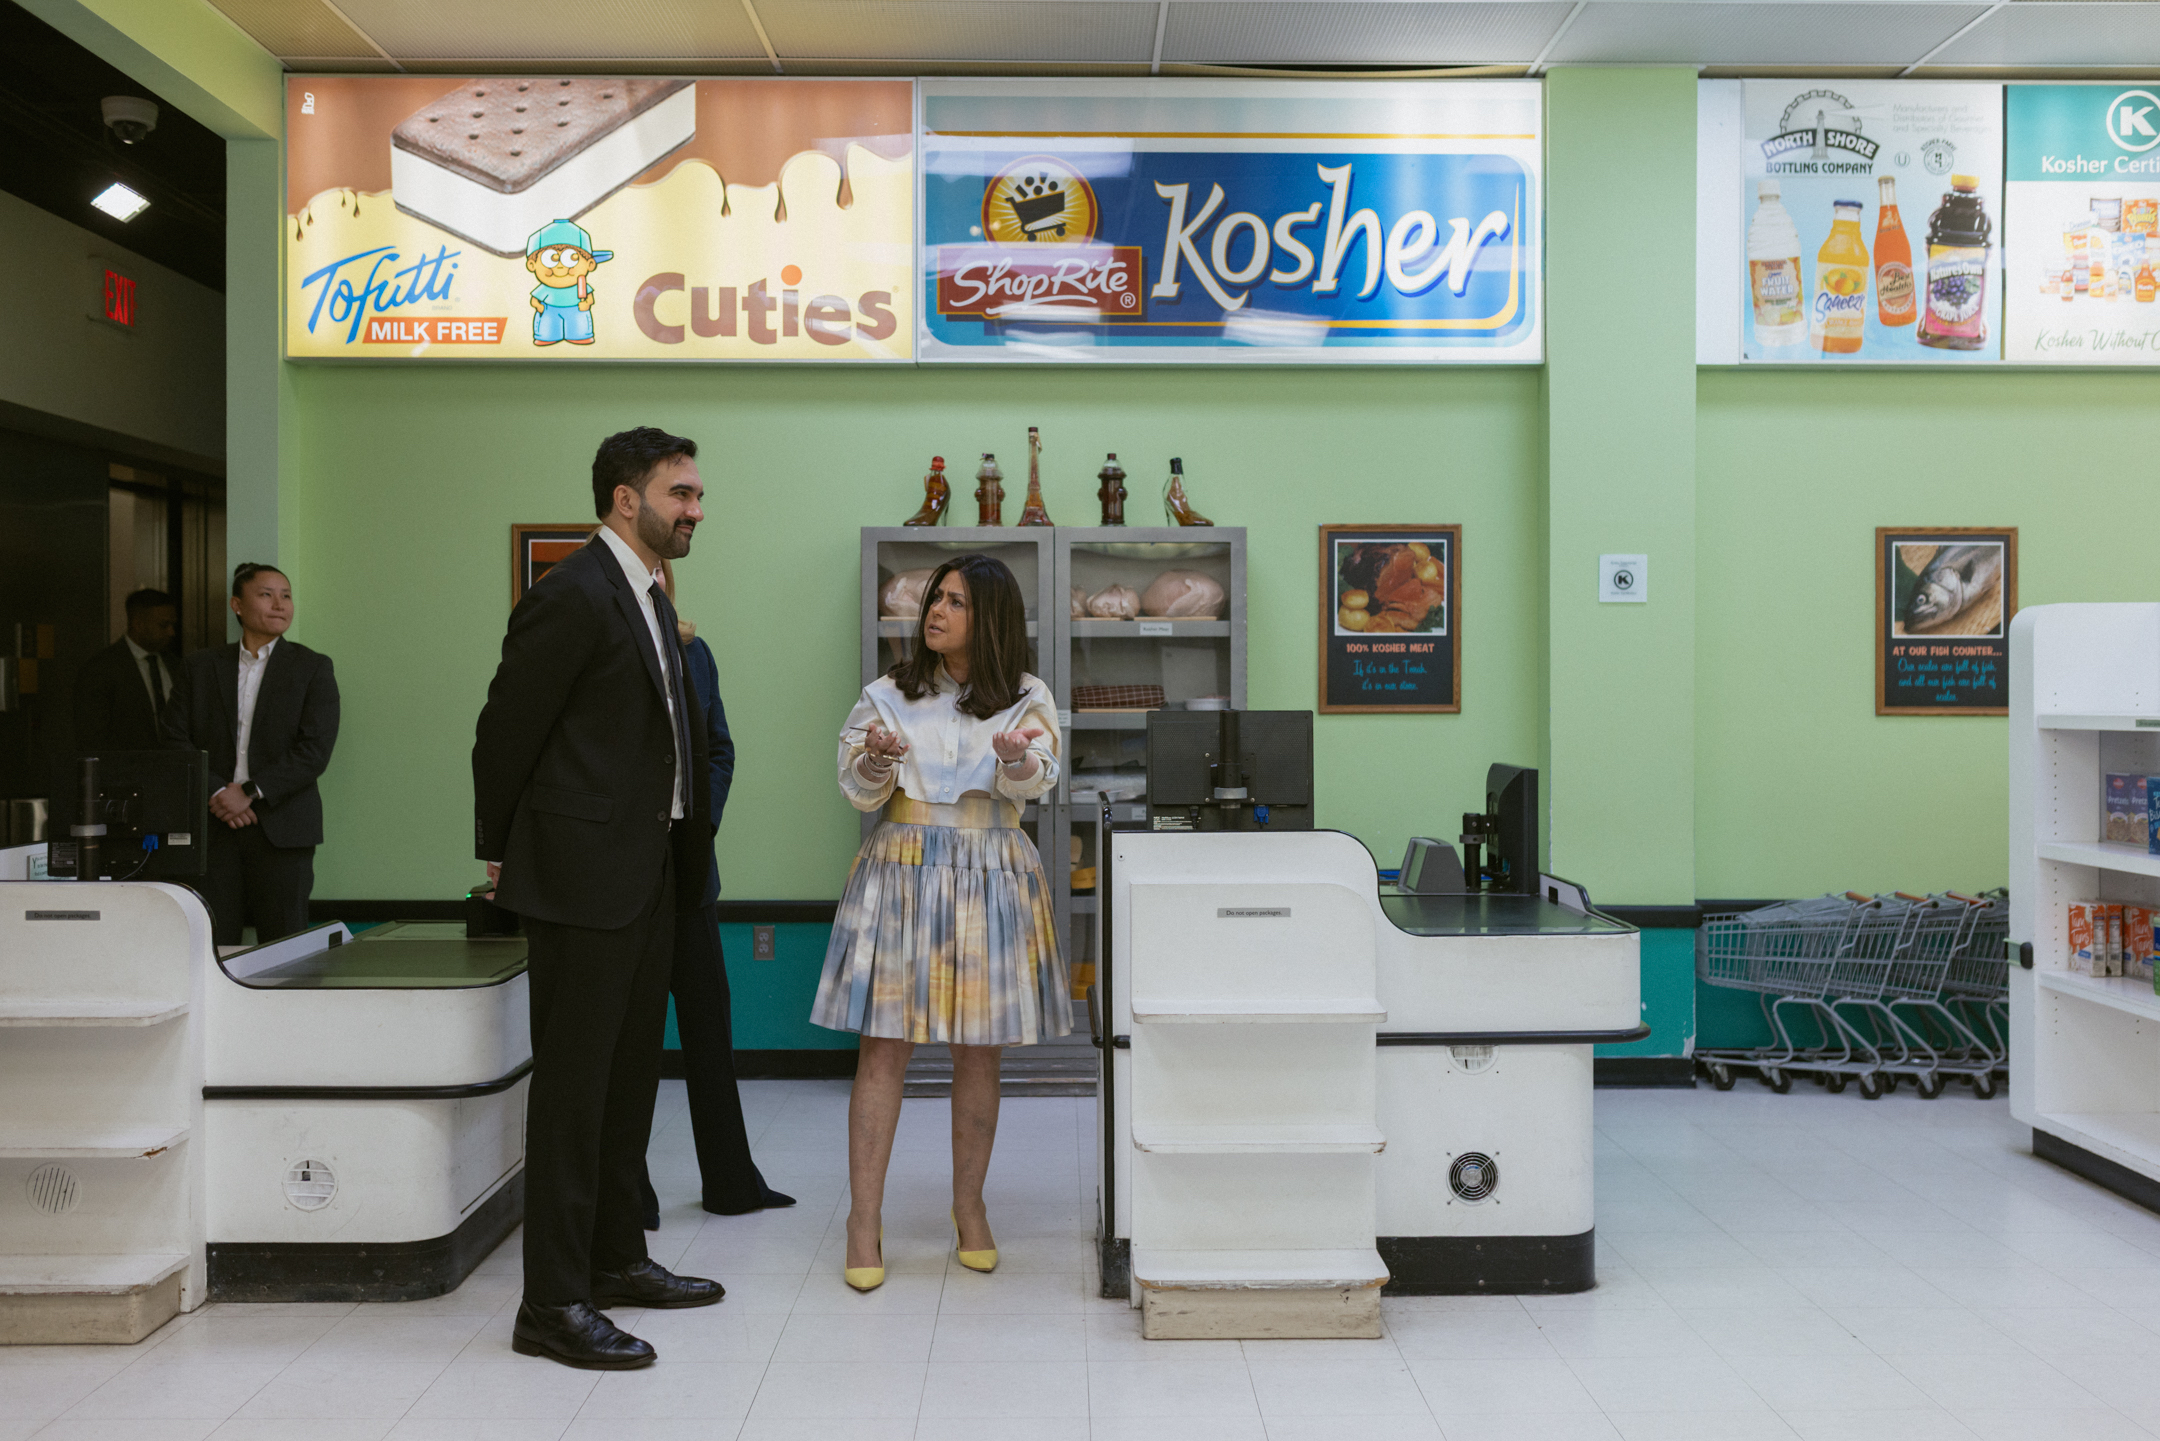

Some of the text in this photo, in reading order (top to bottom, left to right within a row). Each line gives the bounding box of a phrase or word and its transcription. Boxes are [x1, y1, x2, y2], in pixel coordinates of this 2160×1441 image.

[2120, 106, 2158, 136] K
[1763, 131, 1876, 158] NORTH SHORE
[1766, 162, 1873, 175] BOTTLING COMPANY
[2041, 154, 2108, 173] Kosher
[1151, 162, 1508, 311] Kosher
[950, 256, 1128, 309] ShopRite
[1760, 285, 1794, 297] WATER
[105, 268, 136, 327] EXIT
[301, 244, 461, 344] Tofutti
[633, 265, 897, 345] Cuties
[371, 322, 498, 341] MILK FREE
[2035, 328, 2083, 351] Kosher
[2089, 328, 2152, 351] Without
[1346, 643, 1435, 653] 100% KOSHER MEAT
[1893, 646, 1905, 656] AT
[1908, 646, 1928, 656] OUR
[1930, 646, 1949, 656] FISH
[1353, 660, 1364, 677] If
[1956, 659, 1969, 674] full
